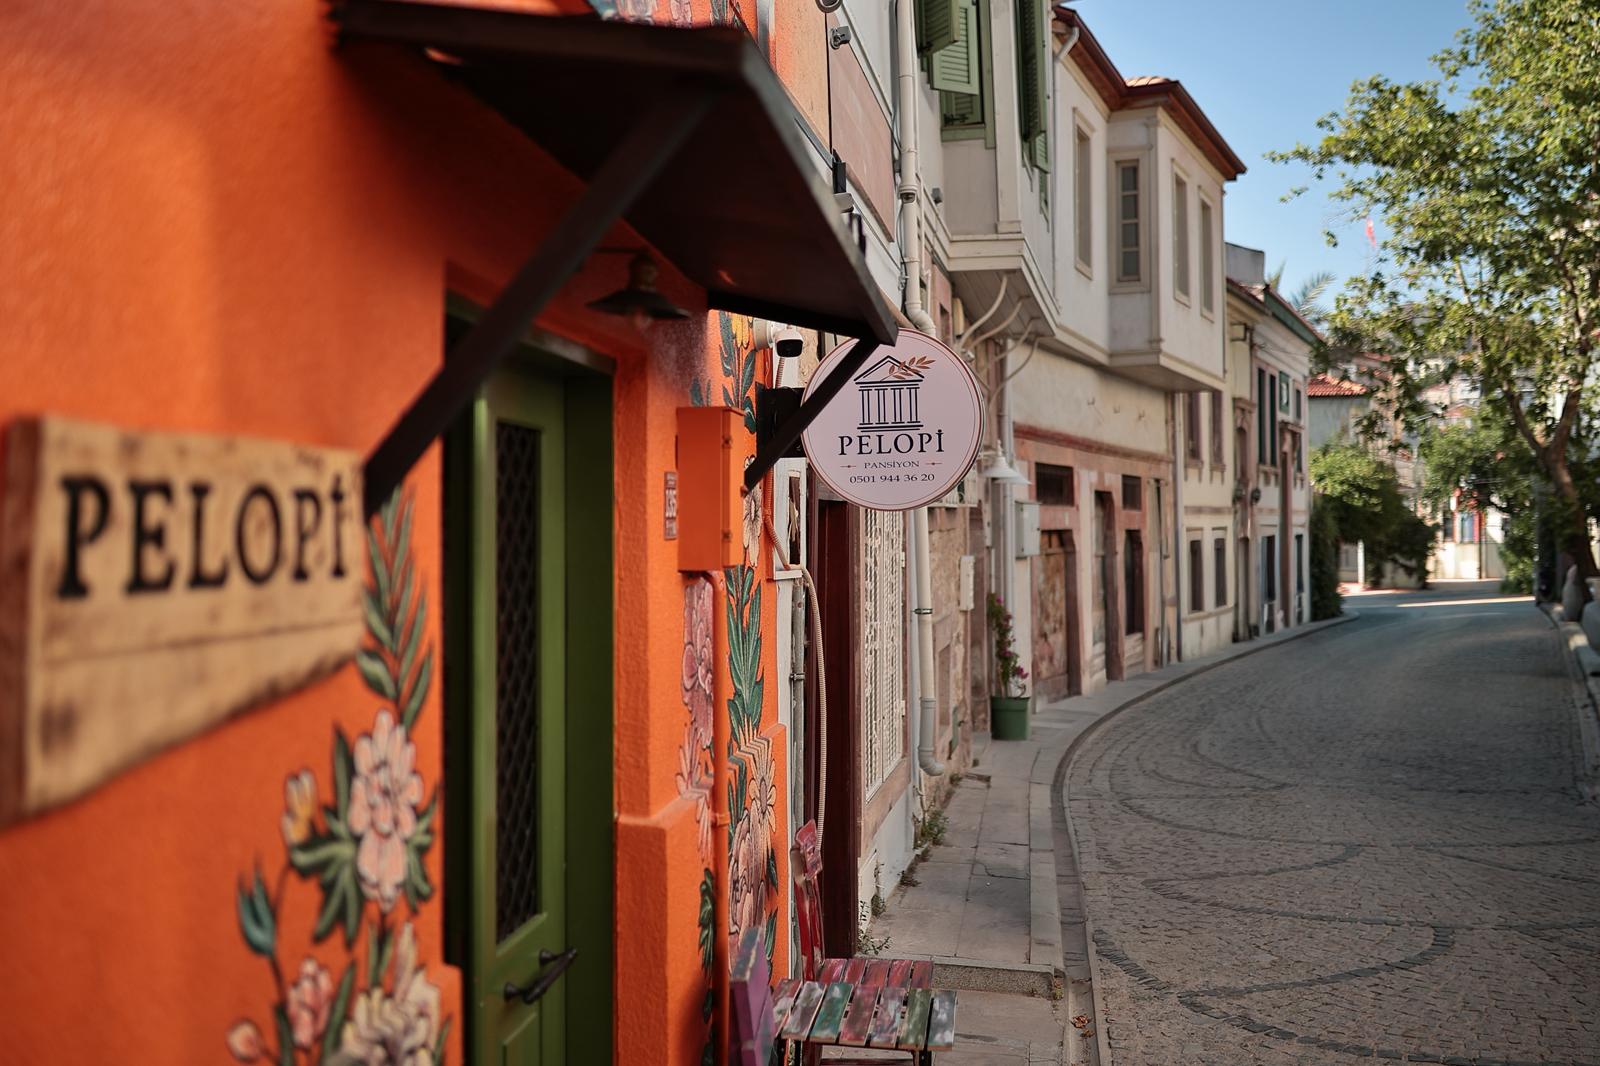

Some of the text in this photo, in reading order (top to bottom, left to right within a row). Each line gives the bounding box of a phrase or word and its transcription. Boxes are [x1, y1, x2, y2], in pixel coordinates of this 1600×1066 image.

[864, 460, 920, 469] PANSİYON
[849, 473, 935, 484] 0501 944 36 20
